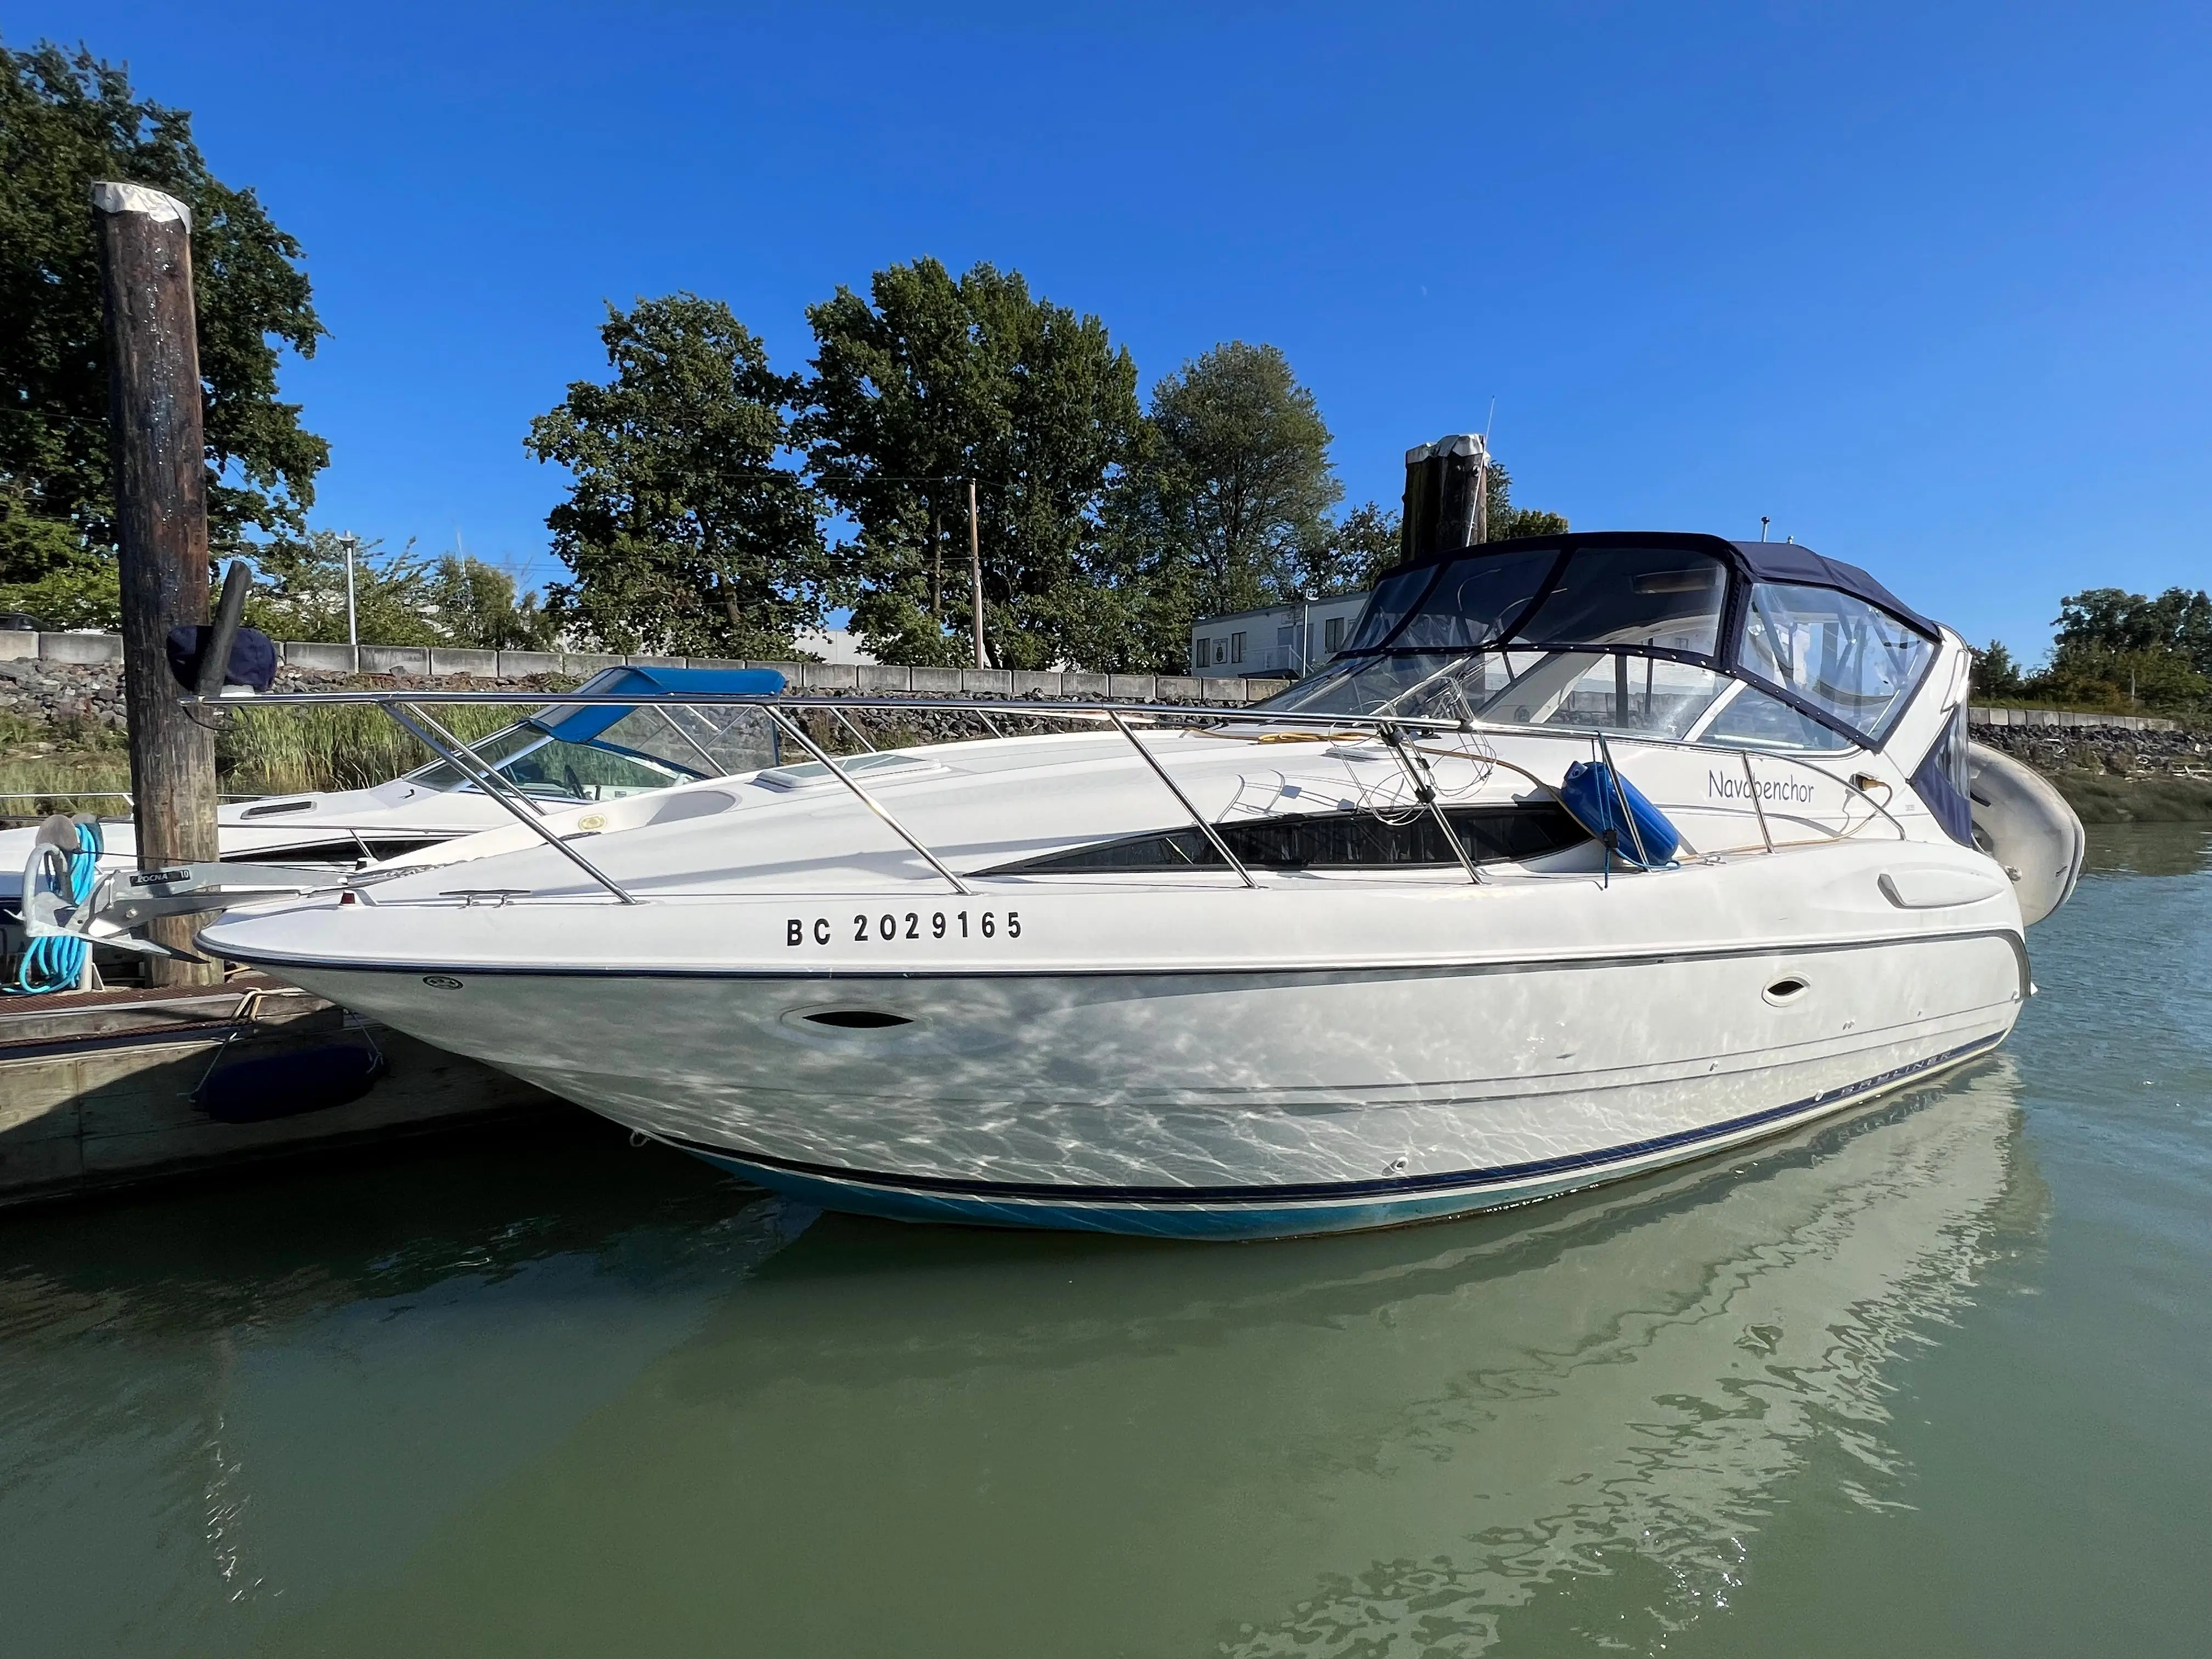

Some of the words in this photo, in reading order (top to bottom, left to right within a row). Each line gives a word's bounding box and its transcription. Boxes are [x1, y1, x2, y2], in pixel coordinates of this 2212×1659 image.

[180, 870, 189, 879] 10
[787, 918, 831, 946] BC
[854, 911, 1022, 941] 2029165
